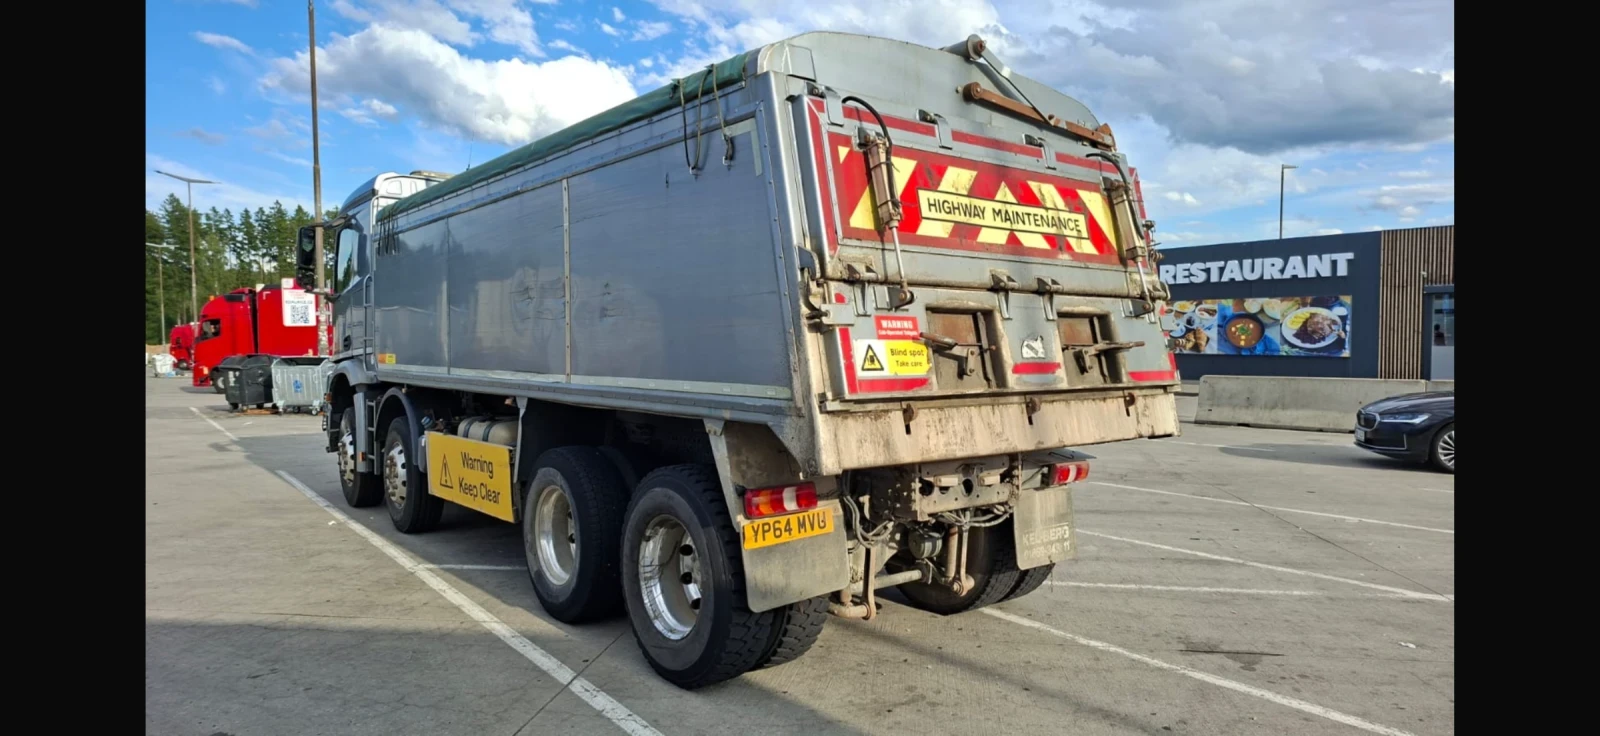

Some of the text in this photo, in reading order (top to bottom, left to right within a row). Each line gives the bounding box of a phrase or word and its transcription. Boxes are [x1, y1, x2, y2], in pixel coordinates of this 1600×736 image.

[927, 198, 1082, 233] HIGHWAY MAINTENANCE
[1159, 252, 1355, 285] RESTAURANT
[880, 319, 913, 329] WARNING
[890, 348, 924, 357] Blind spot
[460, 451, 494, 479] Warning
[458, 477, 501, 504] Keep Clear
[751, 511, 827, 543] YP64 MVU
